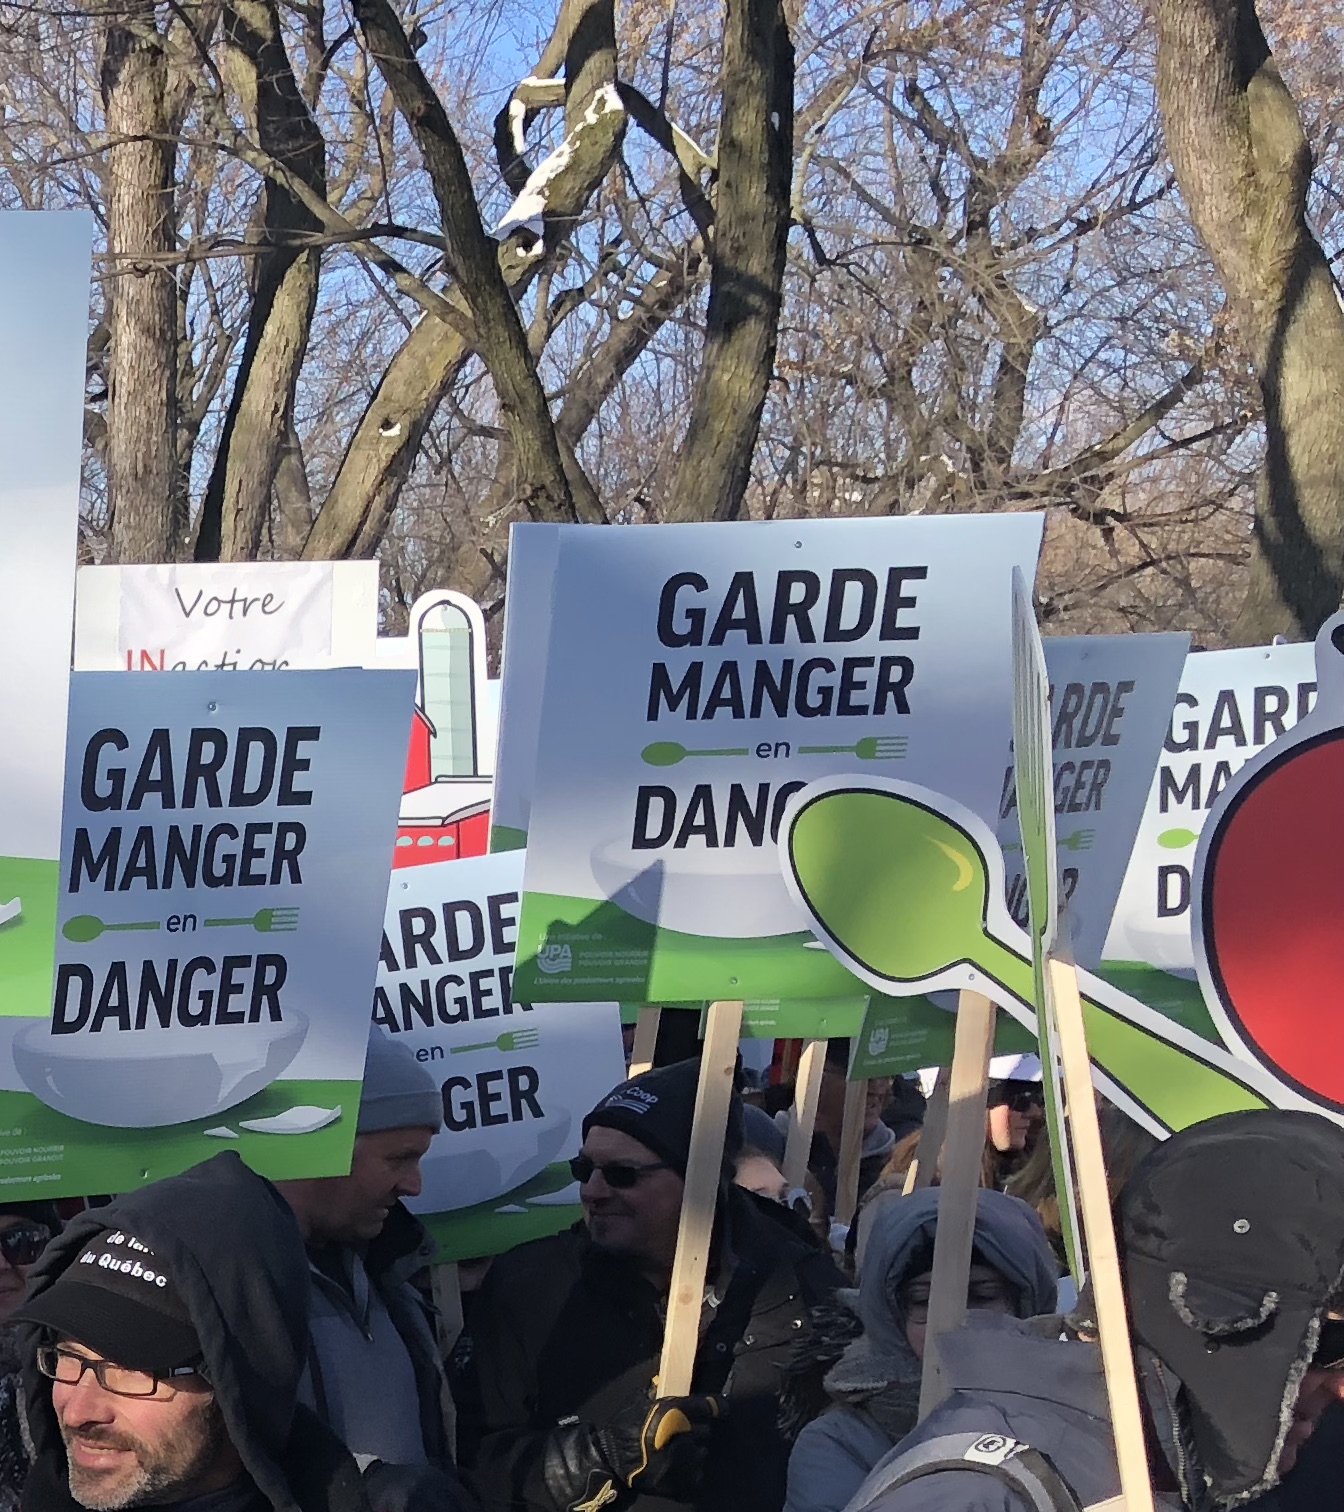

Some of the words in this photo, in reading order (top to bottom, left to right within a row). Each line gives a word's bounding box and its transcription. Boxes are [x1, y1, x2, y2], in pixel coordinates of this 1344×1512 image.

[174, 587, 285, 619] Votre
[656, 566, 928, 648] GARDE
[646, 655, 914, 722] MANGER
[1047, 680, 1136, 750] RDE
[1164, 682, 1318, 754] GAR
[79, 725, 322, 813] GARDE
[755, 736, 791, 759] en
[68, 822, 307, 894] MANGER
[165, 910, 198, 933] en
[50, 953, 288, 1036] DANGER
[371, 965, 534, 1034] ANGE
[415, 1045, 444, 1063] en
[441, 1065, 545, 1132] GER
[98, 1253, 167, 1288] Québec
[106, 1230, 125, 1245] de
